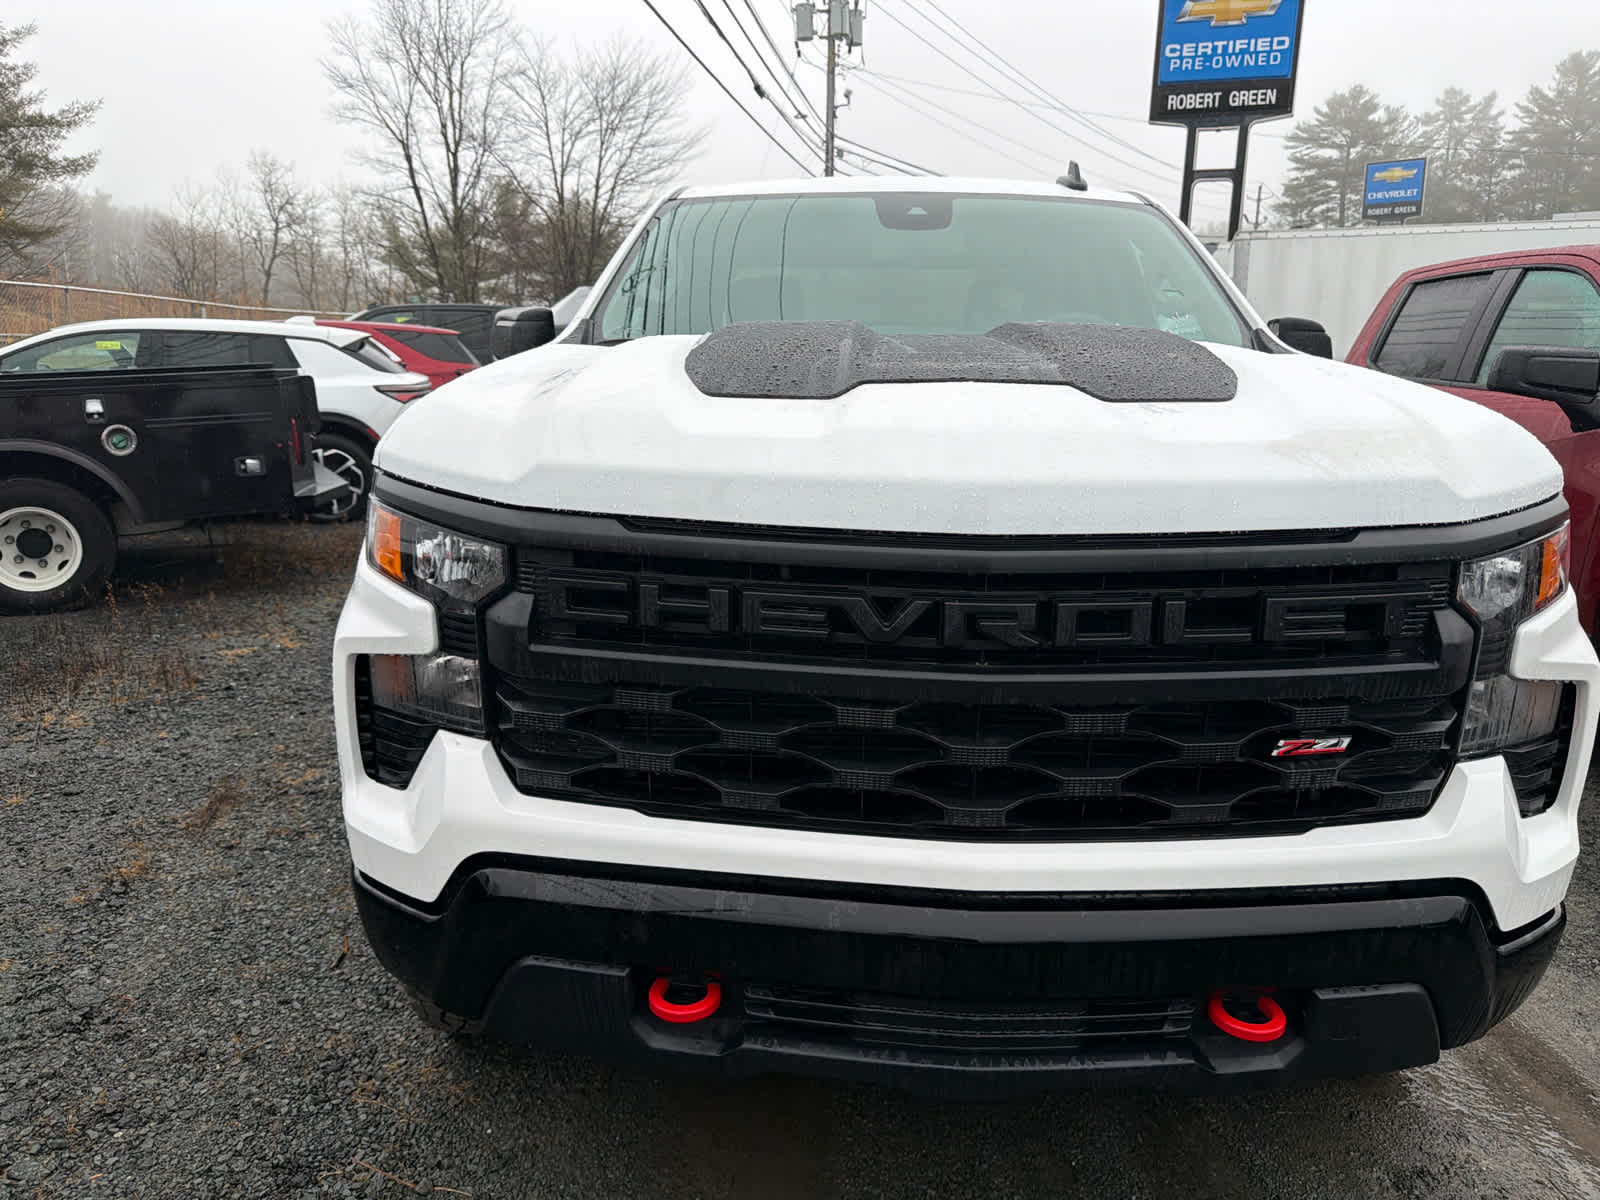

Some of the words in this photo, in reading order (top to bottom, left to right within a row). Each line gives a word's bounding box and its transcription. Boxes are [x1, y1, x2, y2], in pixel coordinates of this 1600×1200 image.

[1165, 36, 1290, 57] CERTIFIED
[1169, 52, 1281, 72] PRE-OWNED
[1167, 92, 1222, 110] ROBERT
[1229, 88, 1277, 107] GREEN
[1367, 188, 1419, 200] CHEVROLET
[1367, 207, 1392, 216] ROBERT
[543, 573, 1424, 648] CHEVROLET
[1271, 737, 1352, 756] Z71
